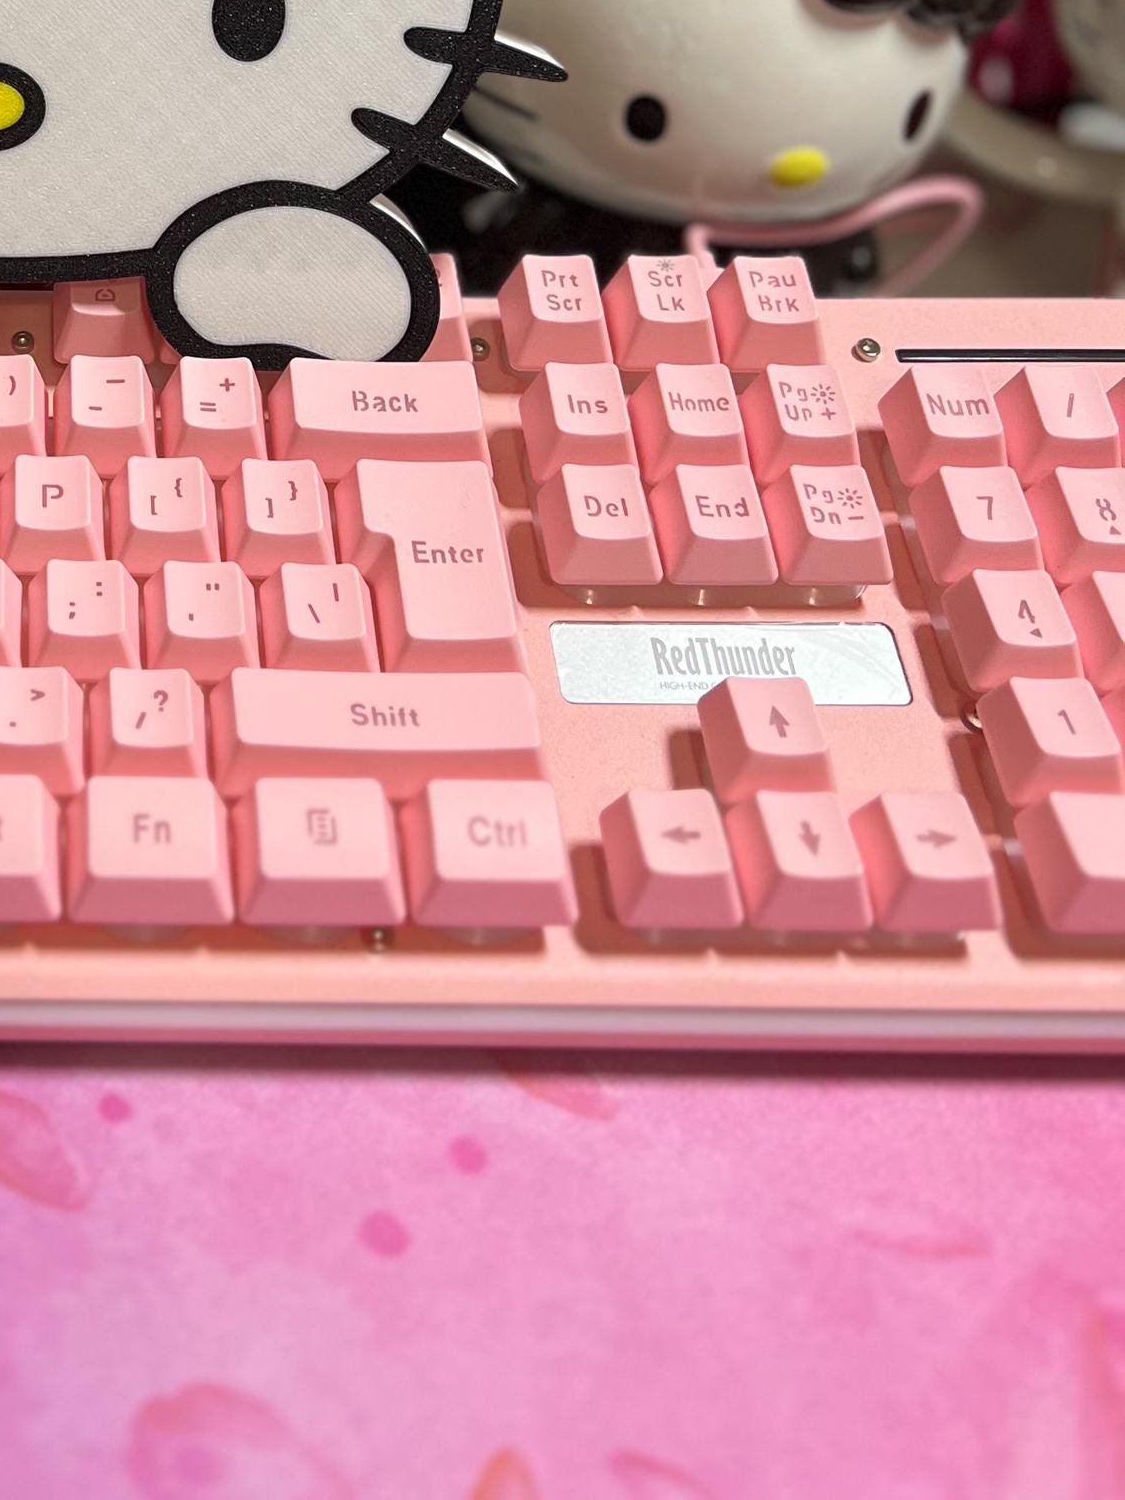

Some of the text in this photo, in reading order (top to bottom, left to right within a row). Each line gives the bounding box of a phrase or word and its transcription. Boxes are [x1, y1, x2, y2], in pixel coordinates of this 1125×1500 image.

[541, 270, 578, 287] Prt
[648, 271, 682, 287] Scr
[749, 271, 797, 287] Pau
[547, 294, 581, 311] Scr
[657, 294, 685, 311] Lk
[758, 295, 799, 312] Brk
[200, 378, 235, 412] = +
[352, 391, 418, 412] Back
[668, 392, 729, 412] Home
[779, 382, 808, 402] Pg
[567, 395, 608, 414] Ins
[926, 394, 990, 416] Num
[42, 484, 64, 508] P
[803, 484, 834, 503] Pg
[584, 496, 628, 517] Del
[695, 495, 749, 517] End
[977, 496, 993, 520] 7
[1096, 499, 1116, 521] 8
[411, 540, 483, 563] Enter
[1018, 600, 1035, 624] 4
[650, 637, 796, 675] RedThunder
[31, 689, 45, 701] >
[154, 690, 168, 711] ?
[350, 703, 419, 726] Shift
[1058, 710, 1076, 734] 1
[133, 813, 171, 843] Fn
[467, 815, 526, 847] Ctrl
